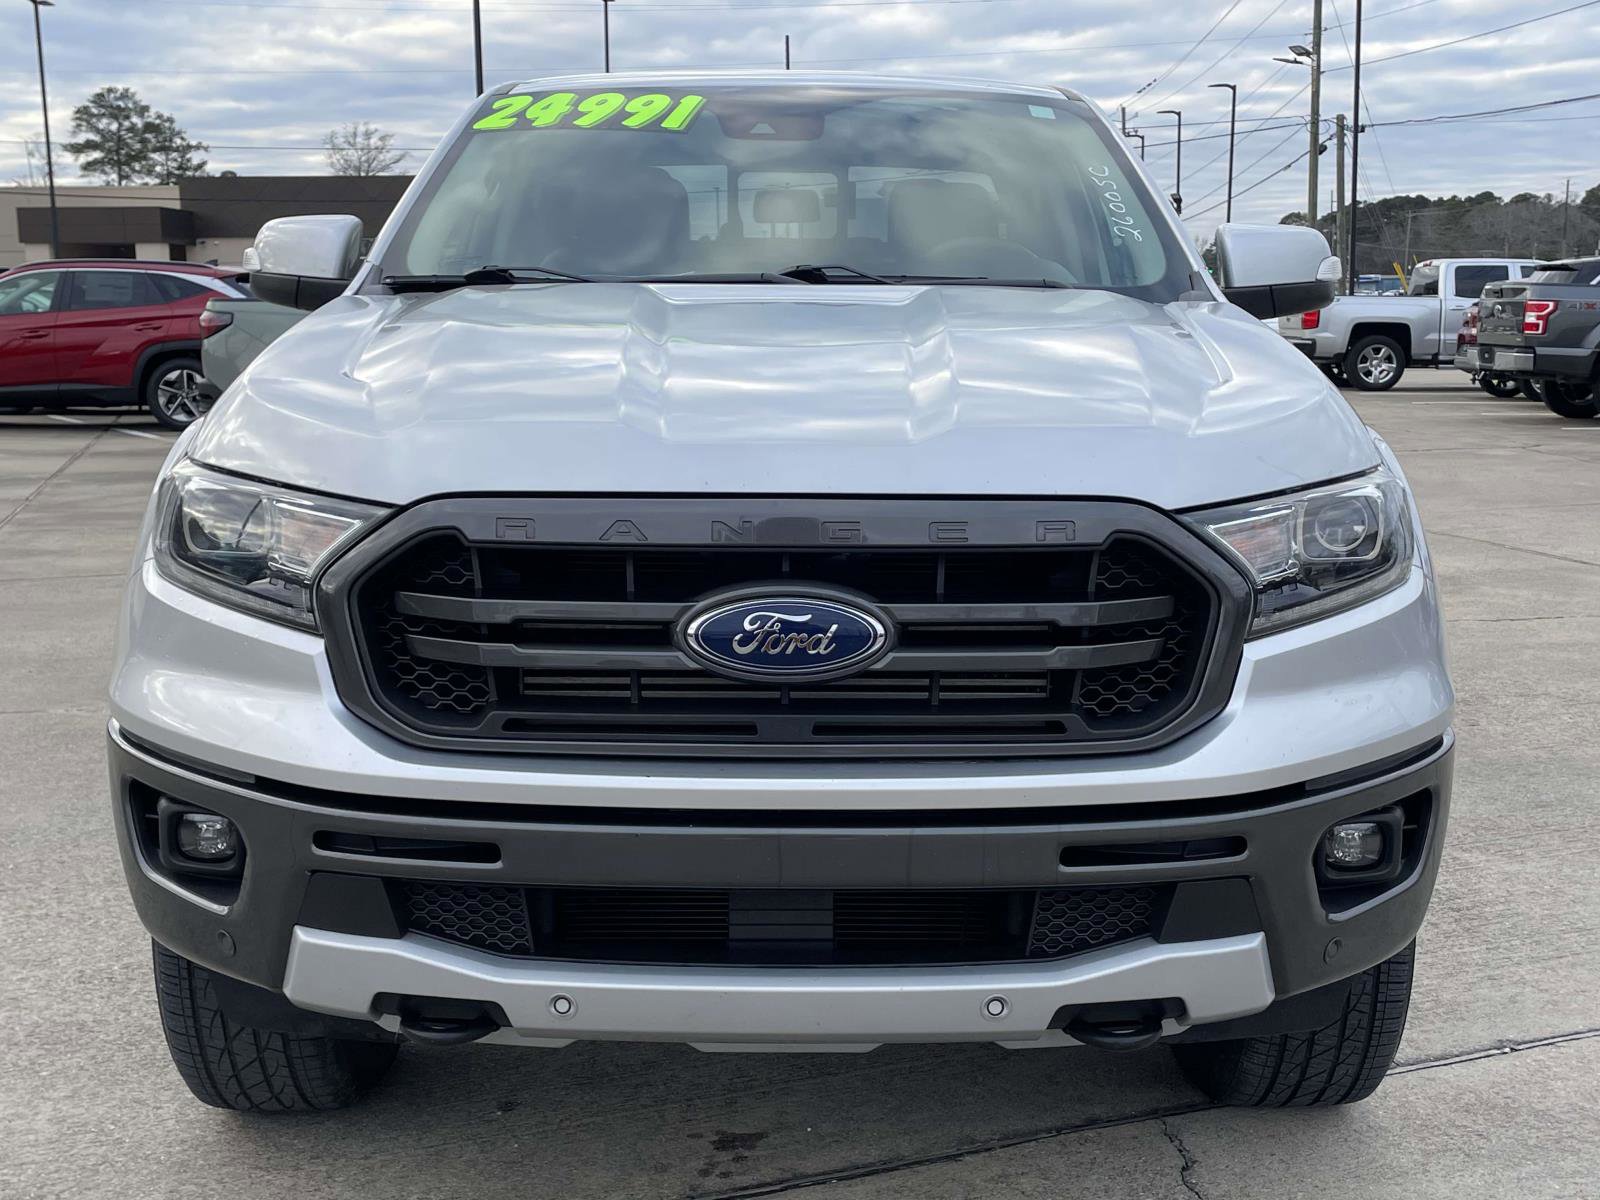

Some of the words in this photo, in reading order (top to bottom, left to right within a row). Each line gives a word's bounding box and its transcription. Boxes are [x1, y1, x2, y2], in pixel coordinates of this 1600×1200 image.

[472, 92, 706, 131] 24991
[1088, 165, 1143, 242] 26005C
[495, 516, 1077, 543] RANGER
[732, 611, 840, 656] Ford
